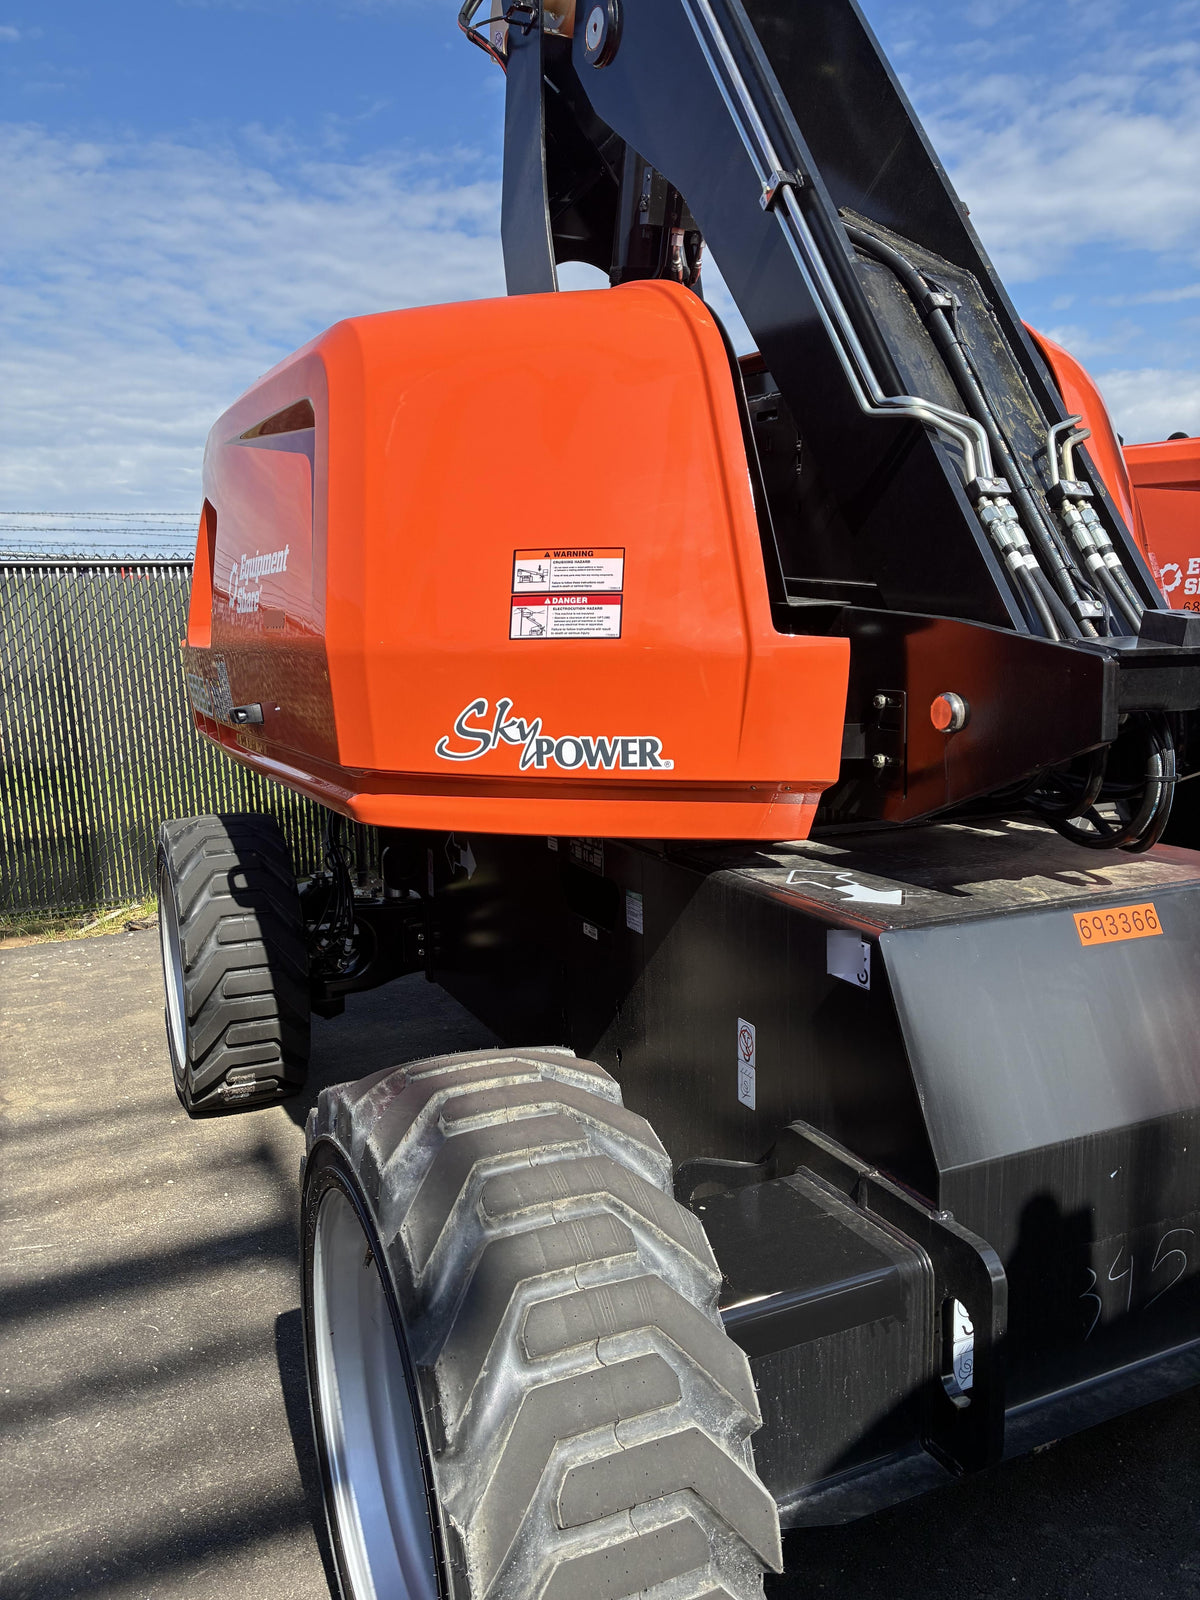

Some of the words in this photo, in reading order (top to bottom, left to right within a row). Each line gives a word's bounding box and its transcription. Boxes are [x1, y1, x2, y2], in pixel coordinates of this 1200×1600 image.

[553, 550, 594, 558] WARNING
[239, 544, 290, 586] Equipment
[552, 596, 588, 604] DANGER
[1079, 908, 1157, 940] 693366
